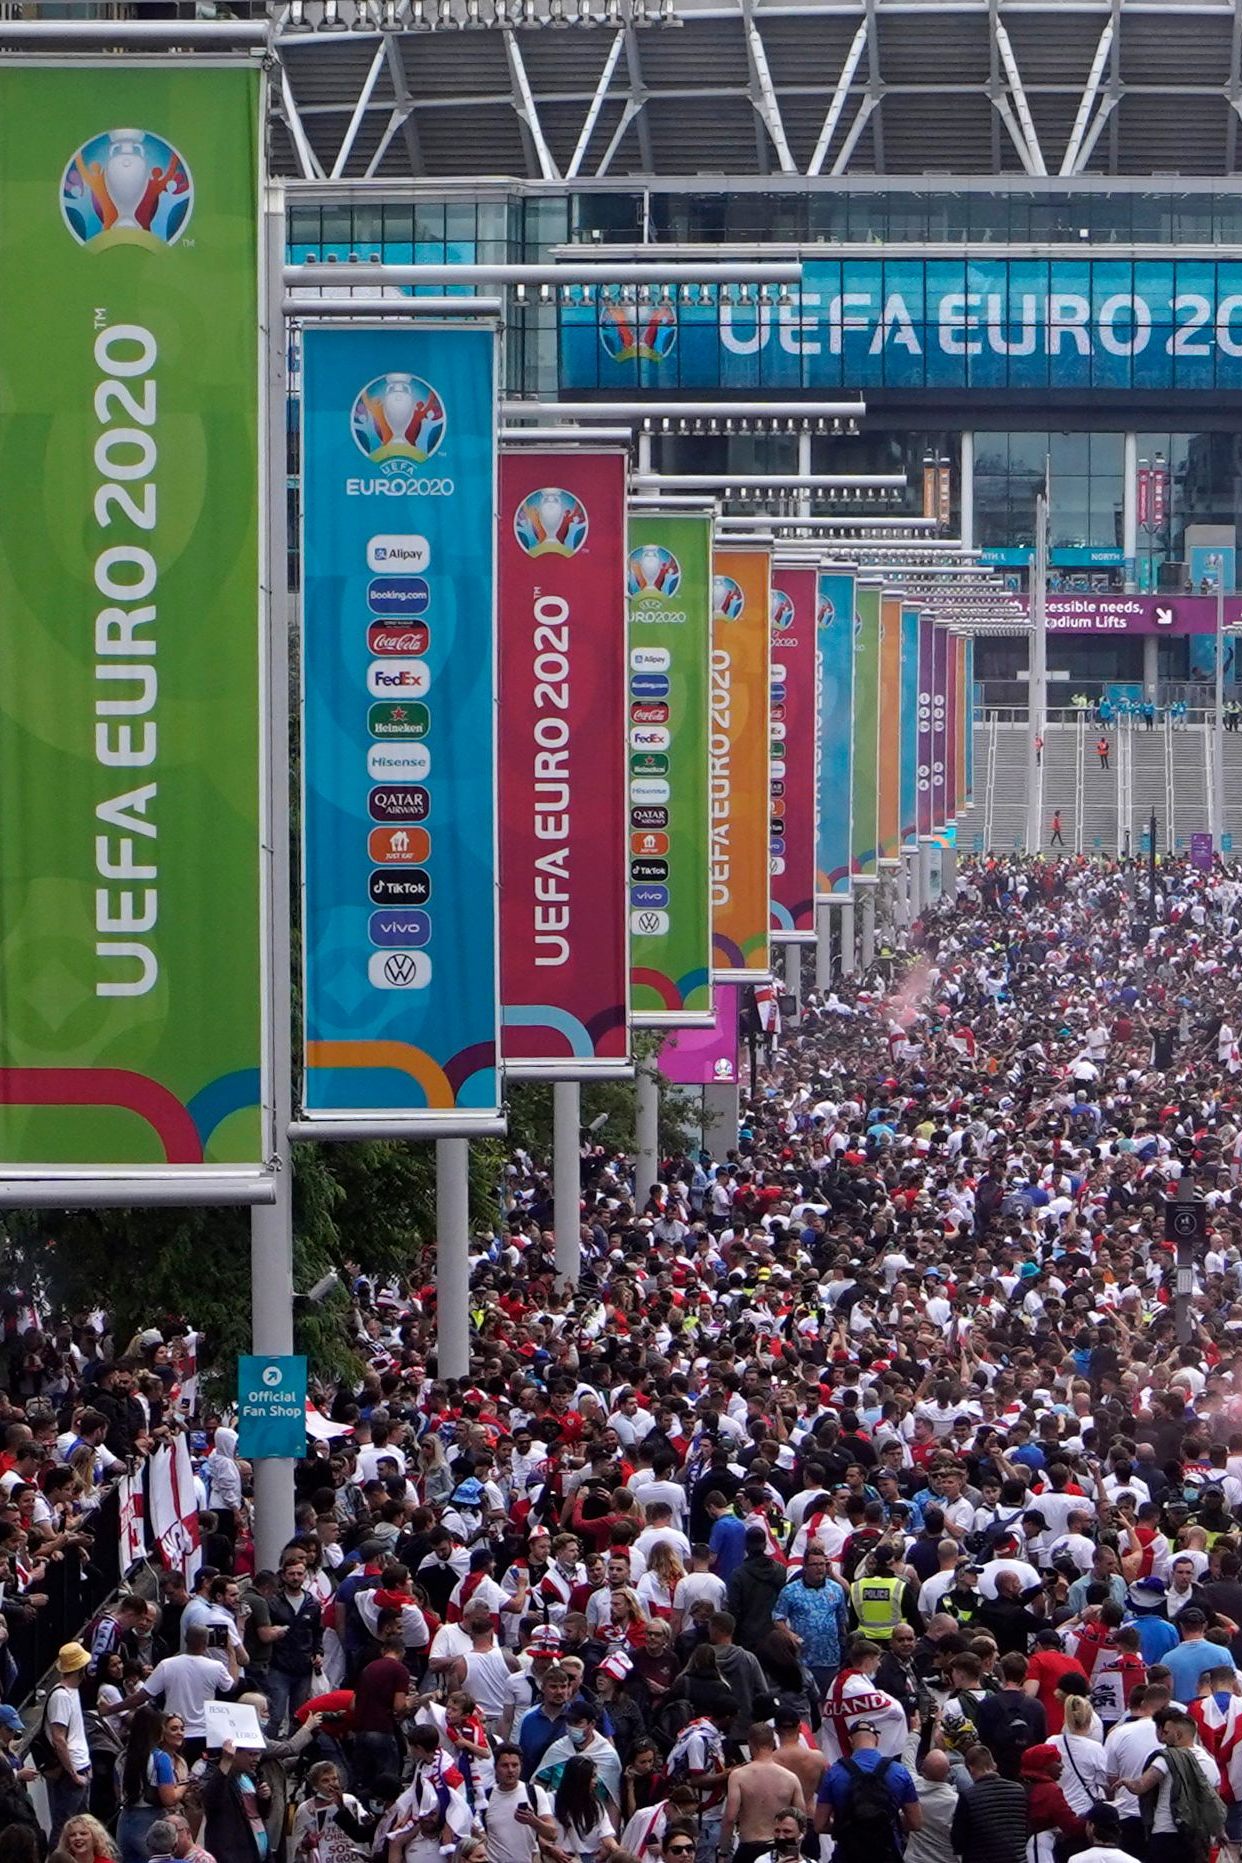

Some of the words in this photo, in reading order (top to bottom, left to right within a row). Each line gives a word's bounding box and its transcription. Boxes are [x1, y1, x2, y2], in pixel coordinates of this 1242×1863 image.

[719, 293, 923, 355] UEFA
[937, 293, 1153, 357] EURO
[94, 324, 158, 529] 2020
[381, 461, 415, 475] UEFA
[389, 548, 422, 560] Alipay
[1091, 553, 1120, 561] NORTH
[370, 590, 427, 602] Booking.com
[1100, 602, 1144, 615] needs,
[1096, 616, 1127, 628] Lifts
[95, 545, 158, 767] EURO
[533, 595, 569, 710] 2020
[375, 671, 422, 686] FedEx
[375, 722, 424, 734] Heineken
[634, 733, 664, 744] FedEx
[372, 757, 426, 768] Hisense
[534, 717, 570, 840] EURO
[711, 733, 731, 819] EURO
[375, 793, 424, 807] QATAR
[386, 806, 424, 815] AIRWAYS
[633, 809, 665, 820] QATAR
[641, 866, 666, 875] TikTok
[711, 823, 730, 906] UEFA
[95, 782, 158, 997] UEFA
[387, 882, 426, 894] TikTok
[534, 847, 570, 966] UEFA
[380, 921, 420, 933] vivo
[248, 1391, 296, 1403] Official
[243, 1406, 266, 1417] Fan
[269, 1406, 302, 1419] Shop
[864, 1588, 889, 1600] POLICE
[823, 1693, 889, 1716] GLAND
